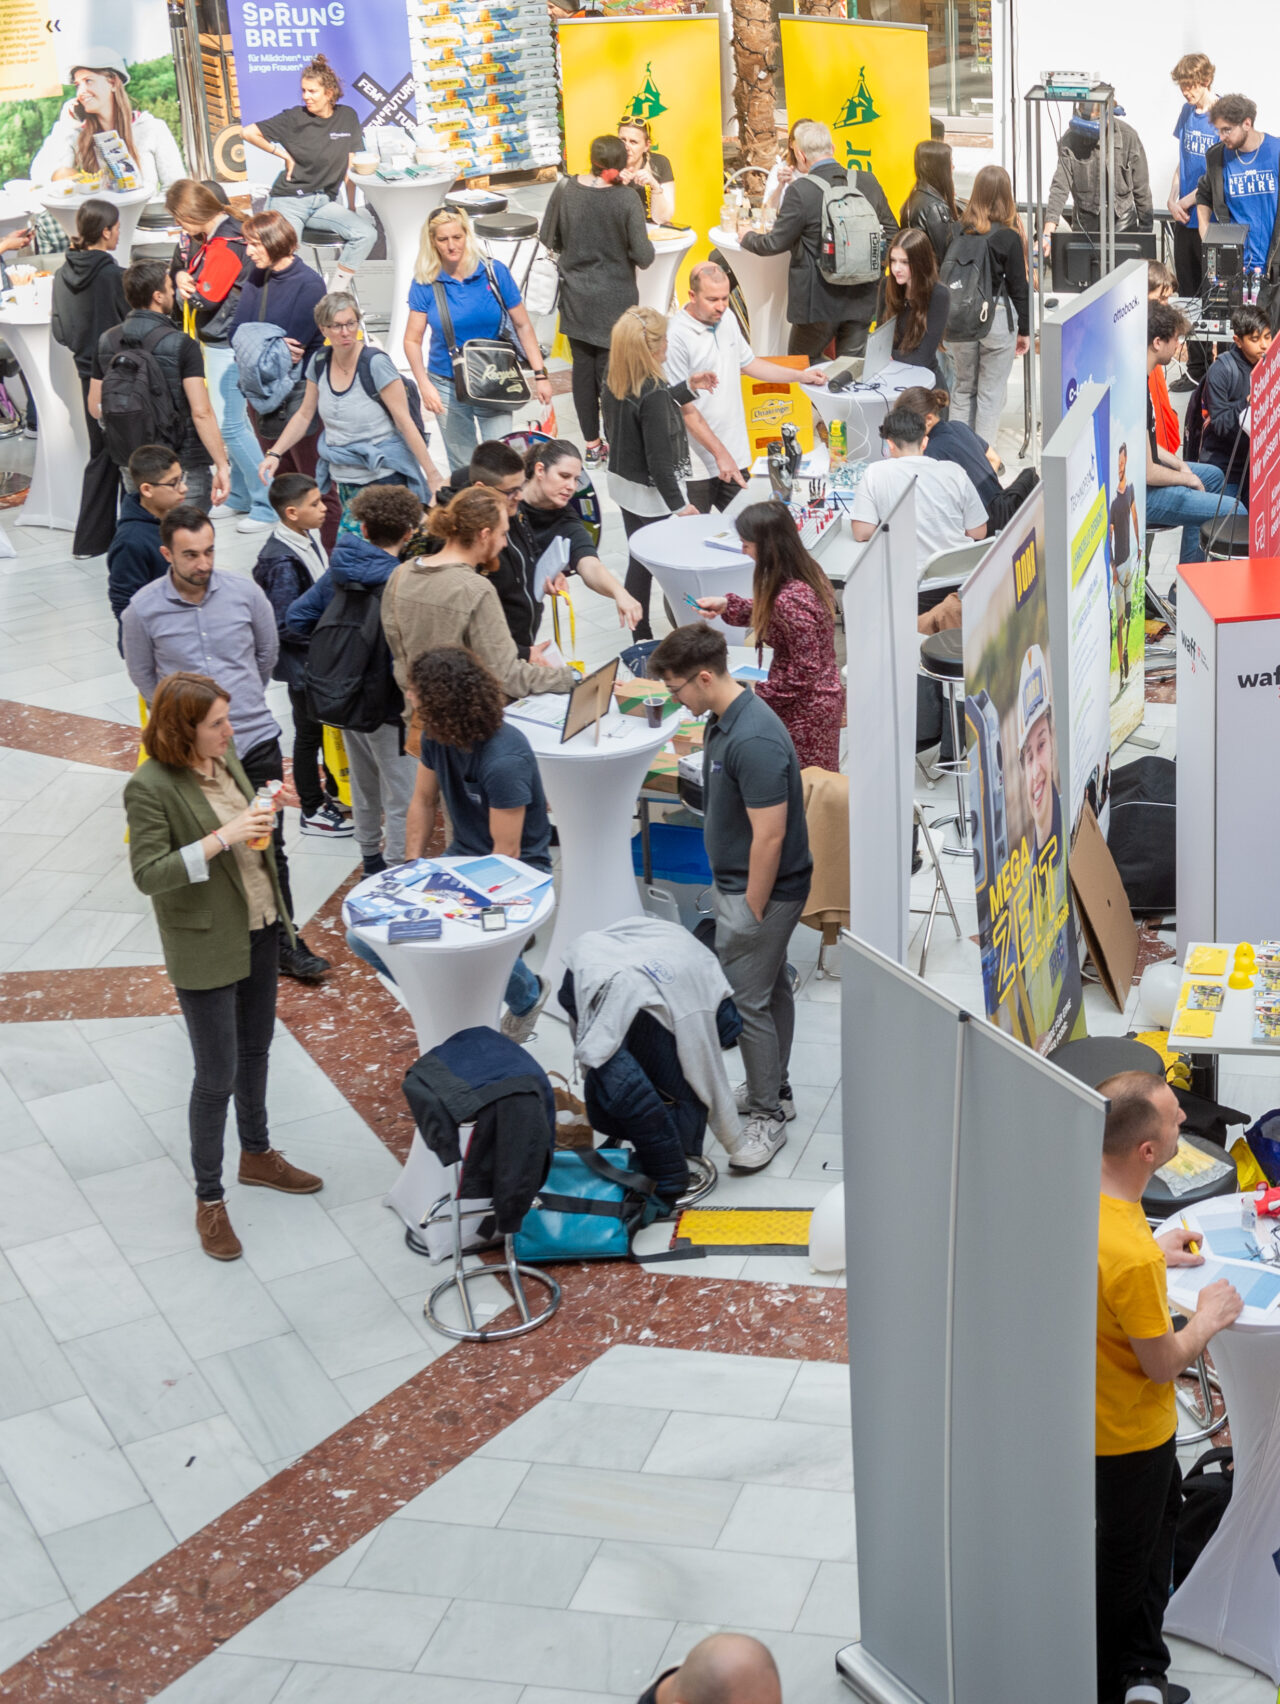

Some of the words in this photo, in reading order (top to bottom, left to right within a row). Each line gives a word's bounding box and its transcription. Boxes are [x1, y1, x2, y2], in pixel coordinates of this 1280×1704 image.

[242, 2, 344, 26] SPRUNG
[245, 28, 319, 47] BRETT
[249, 64, 271, 74] junge
[1229, 180, 1275, 195] LEHRE
[1252, 173, 1274, 181] LEVEL
[1253, 367, 1270, 403] Schule
[1253, 394, 1270, 430] Schule
[1253, 425, 1267, 457] Keine
[1253, 458, 1261, 483] Wir
[989, 835, 1031, 923] MEGA
[992, 834, 1058, 1005] ZEIT
